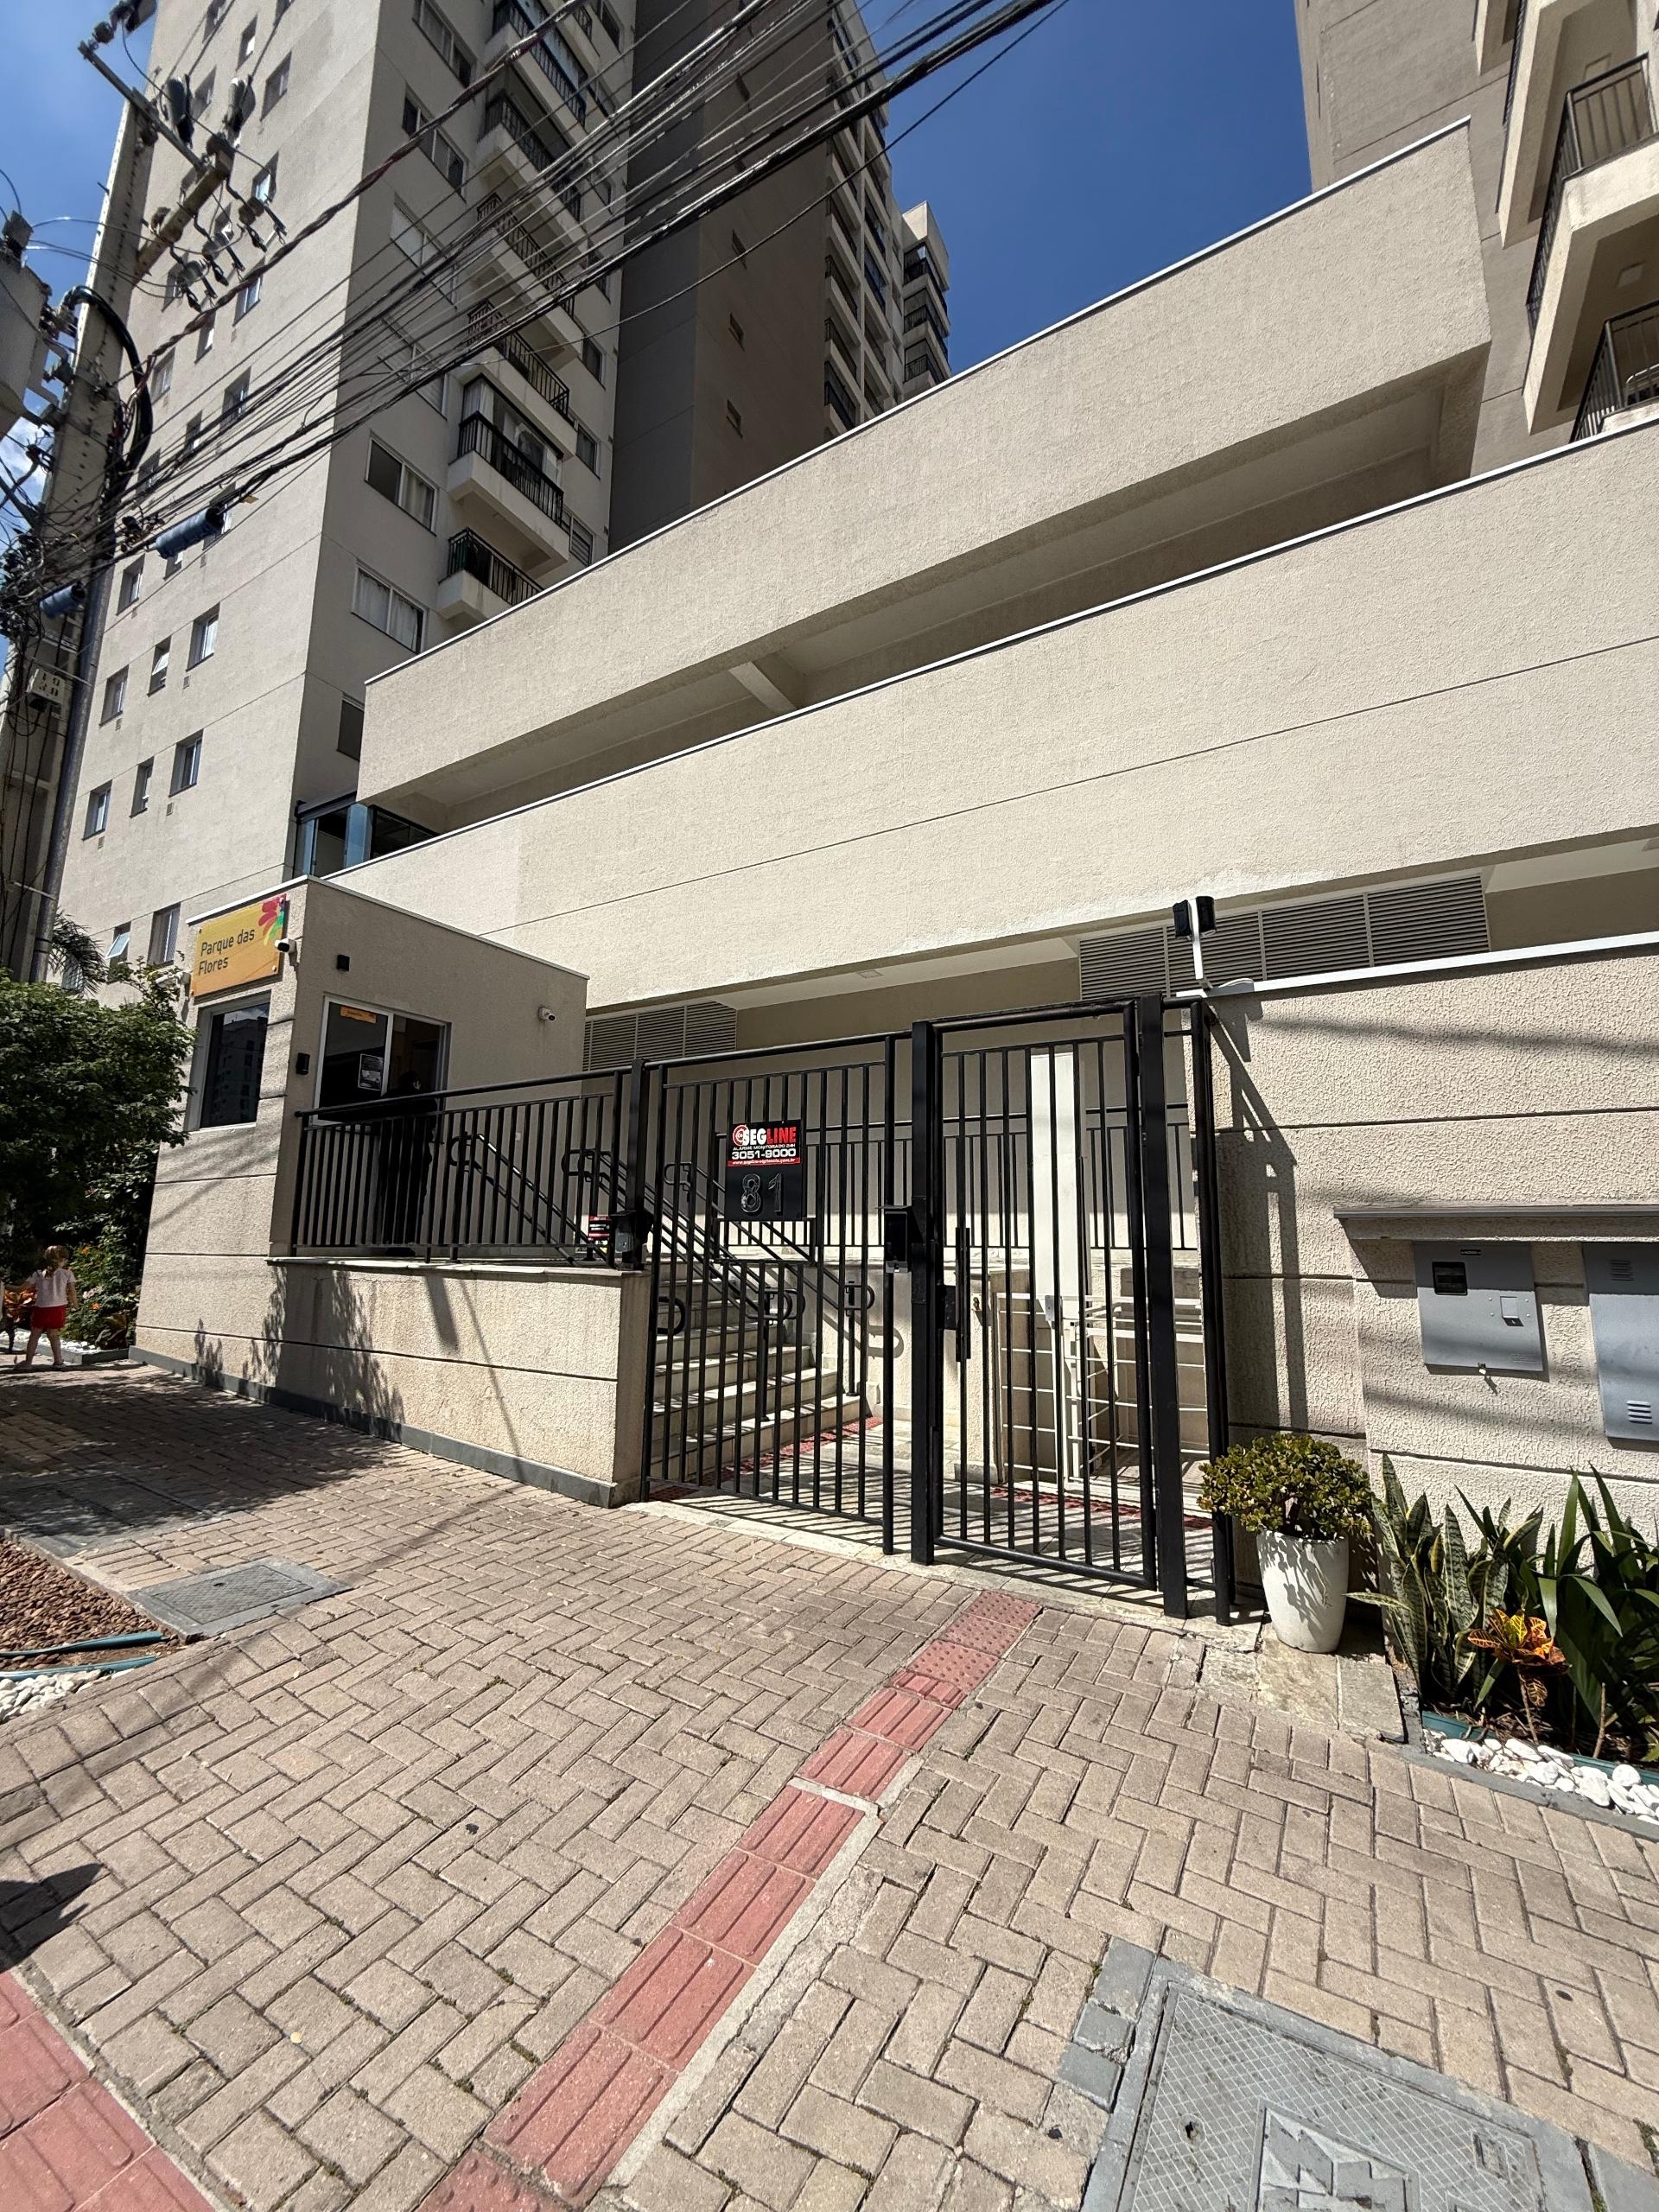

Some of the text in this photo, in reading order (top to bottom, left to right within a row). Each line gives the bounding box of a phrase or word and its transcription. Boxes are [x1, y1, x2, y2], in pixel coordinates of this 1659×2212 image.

[200, 929, 255, 957] Parque das
[198, 957, 229, 976] Flores
[742, 1127, 797, 1146] SEGLINE
[732, 1148, 797, 1160] 3051-9000
[741, 1173, 782, 1213] 81
